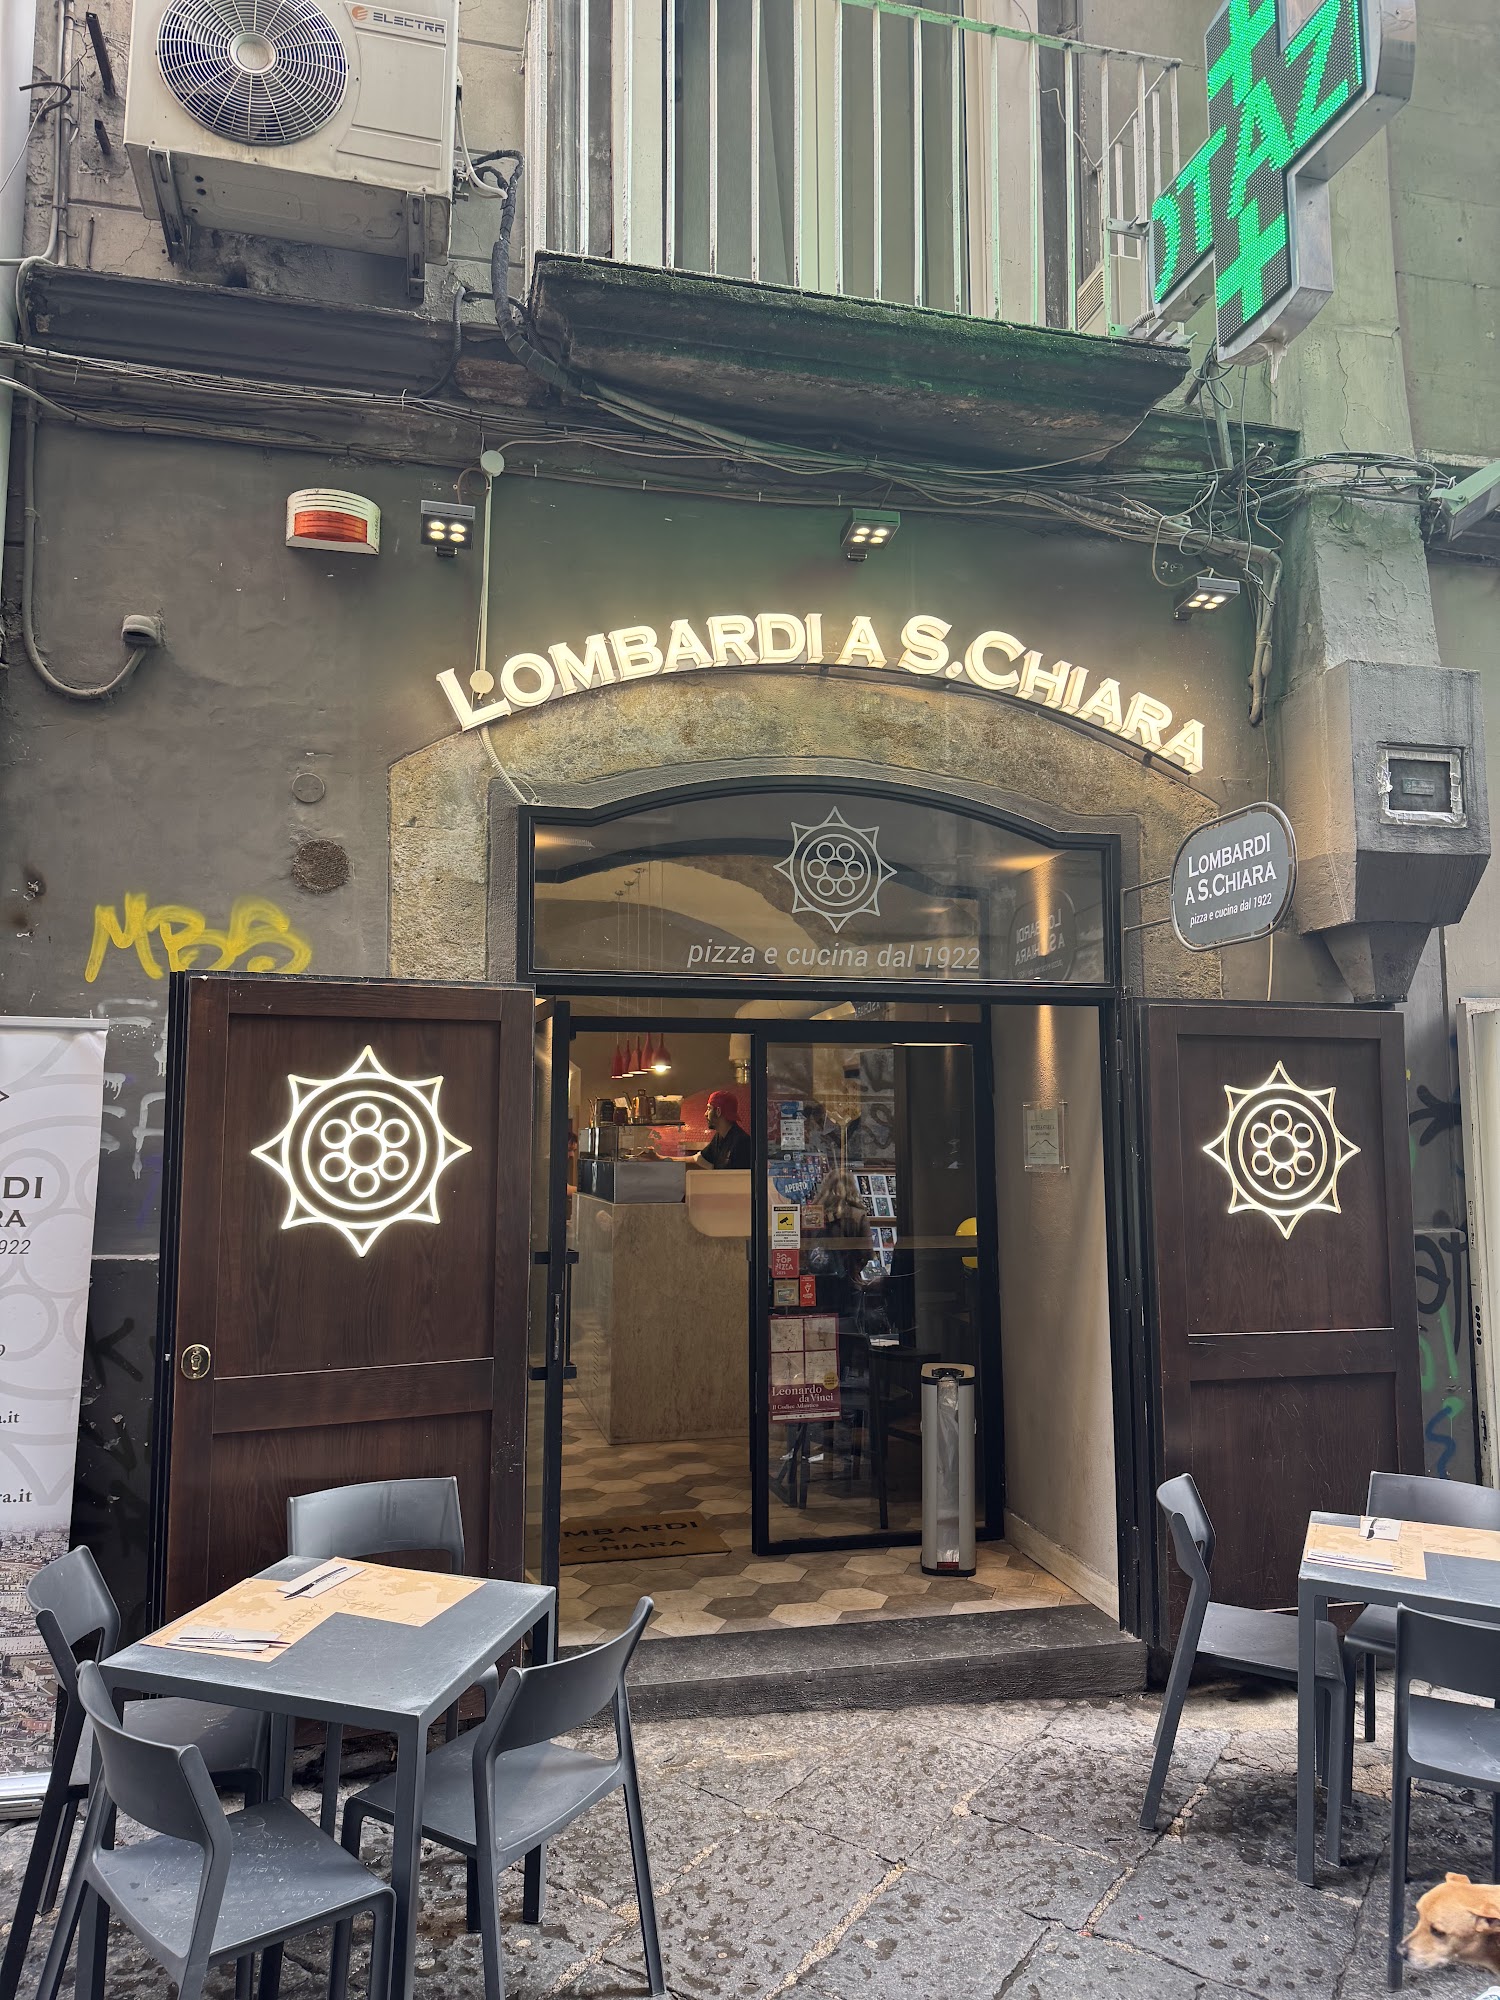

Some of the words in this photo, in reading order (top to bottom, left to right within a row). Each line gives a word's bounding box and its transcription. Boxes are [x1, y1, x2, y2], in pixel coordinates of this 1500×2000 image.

[373, 11, 445, 34] ELECTRA
[436, 613, 823, 732] LOMBARDI
[834, 615, 888, 668] A
[896, 614, 1205, 774] S.CHIARA
[1188, 832, 1271, 878] LOMBARDI
[1185, 886, 1196, 906] A
[1197, 860, 1278, 901] S.CHIARA
[1190, 913, 1208, 928] pizza
[1209, 911, 1214, 920] e
[1215, 903, 1238, 918] cucina
[1239, 897, 1252, 912] dal
[1253, 892, 1272, 909] 1922
[687, 938, 755, 968] pizza
[764, 946, 778, 965] e
[787, 942, 869, 968] cucina
[877, 943, 914, 968] dal
[924, 946, 981, 970] 1922
[772, 1384, 823, 1397] Leonardo
[799, 1395, 809, 1403] da
[811, 1393, 834, 1402] Vinci
[0, 1411, 20, 1425] .it
[0, 1488, 33, 1503] a.it
